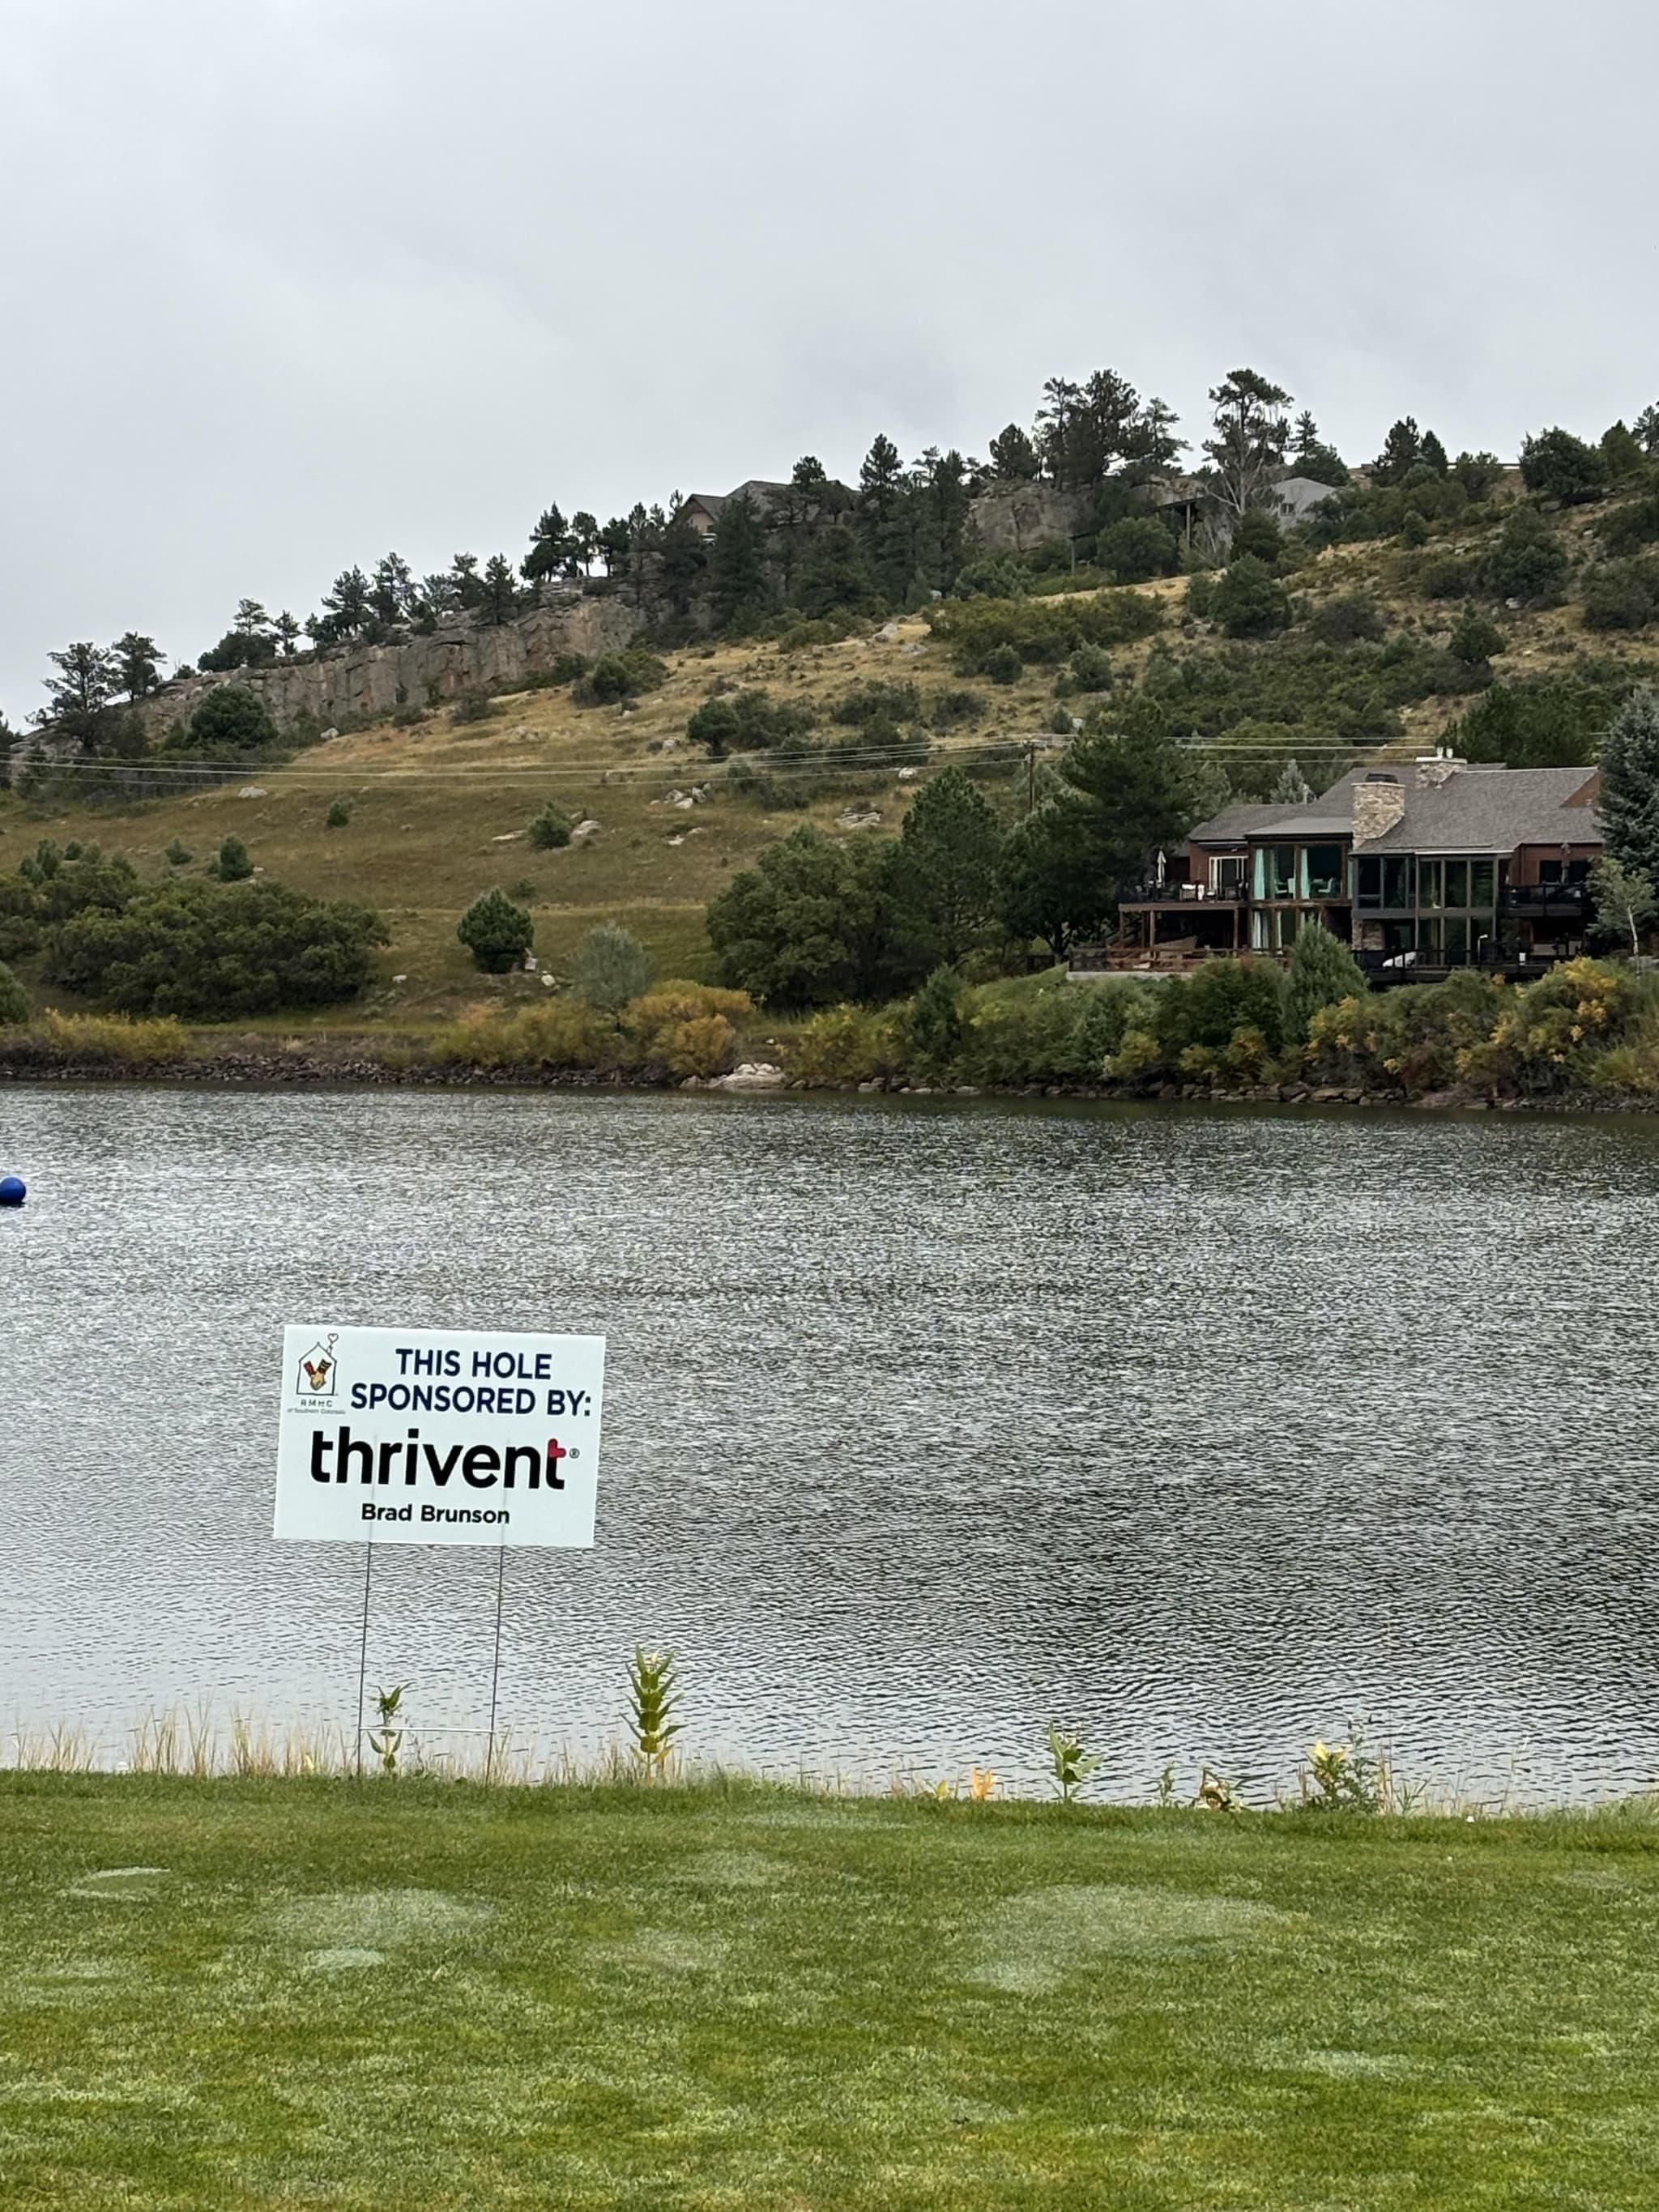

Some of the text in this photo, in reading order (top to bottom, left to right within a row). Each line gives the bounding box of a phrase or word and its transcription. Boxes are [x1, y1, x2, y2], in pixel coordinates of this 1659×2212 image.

[395, 1348, 552, 1380] THIS HOLE
[351, 1383, 591, 1417] SPONSORED BY:
[361, 1502, 510, 1524] Brad Brunson
